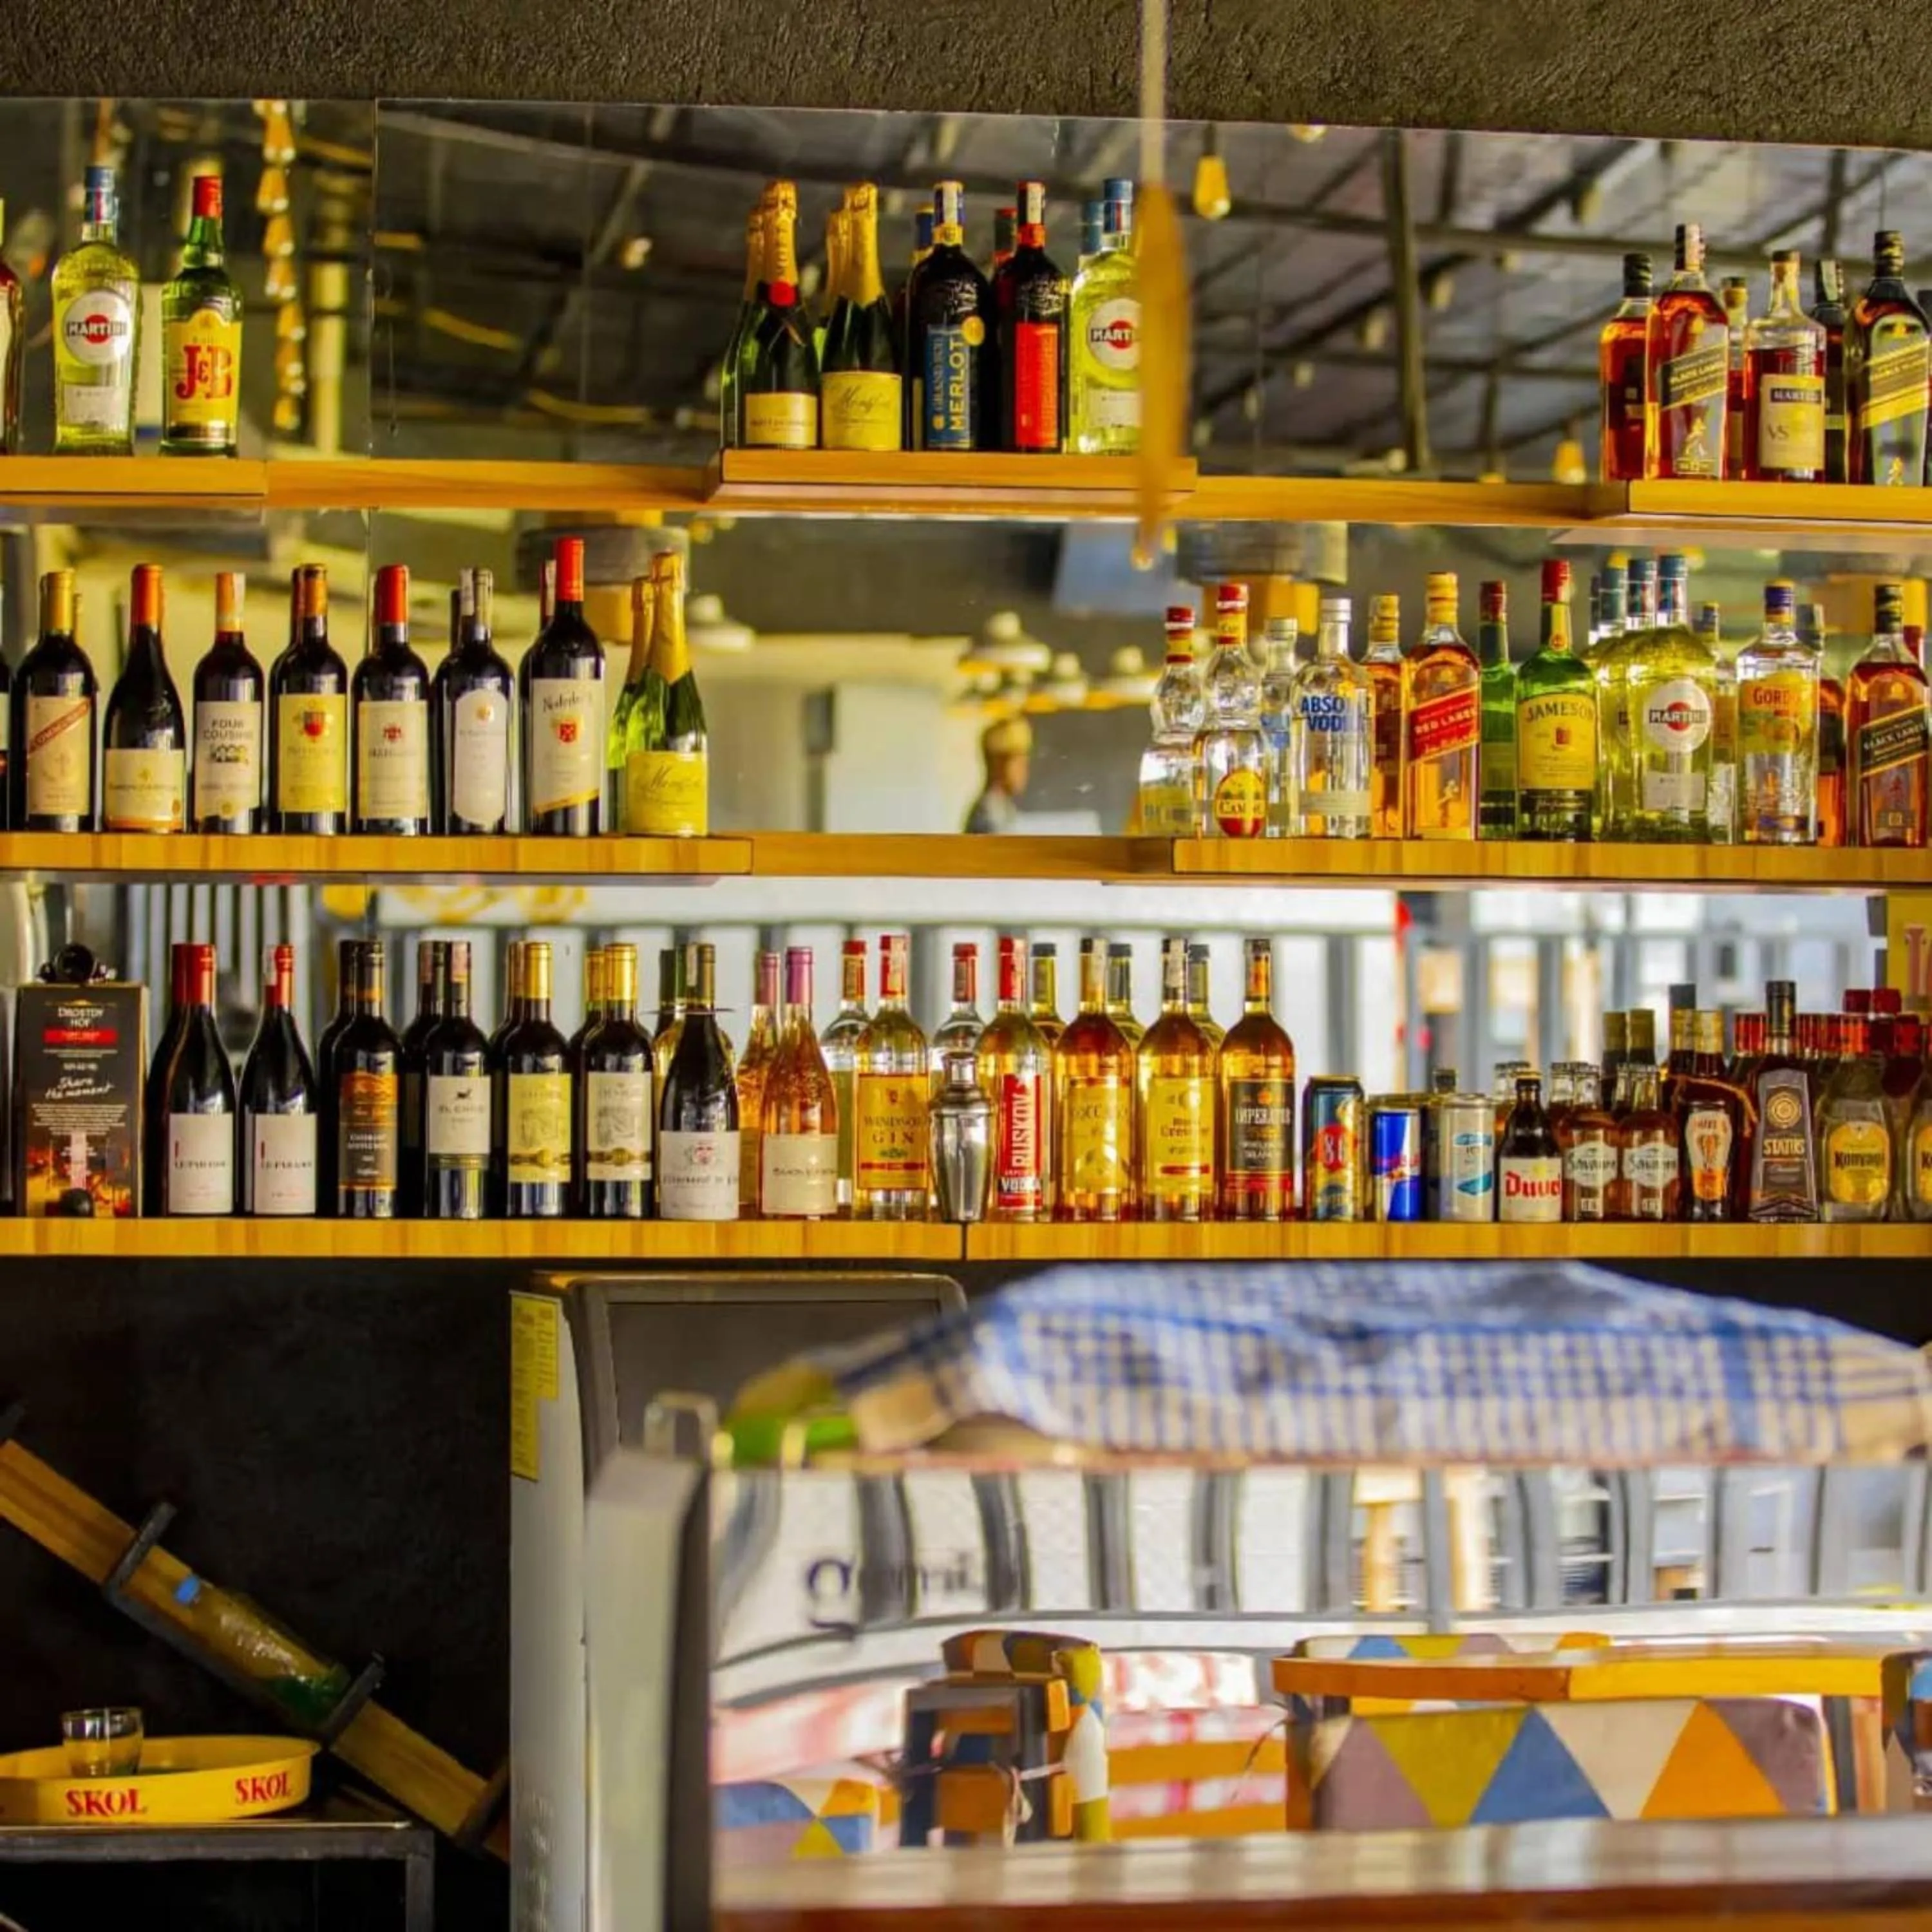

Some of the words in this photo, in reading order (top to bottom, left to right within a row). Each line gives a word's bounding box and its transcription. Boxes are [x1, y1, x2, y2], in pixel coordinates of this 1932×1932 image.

[1092, 328, 1135, 341] MART
[950, 339, 965, 430] MERLOT
[1301, 696, 1345, 713] ABSO
[1525, 701, 1594, 723] JAMESON
[212, 719, 244, 728] FOUR
[1307, 715, 1347, 732] VOD
[1414, 721, 1439, 735] RED
[873, 1132, 914, 1144] GIN
[235, 1771, 291, 1804] SKOL
[66, 1788, 146, 1817] SKOL
